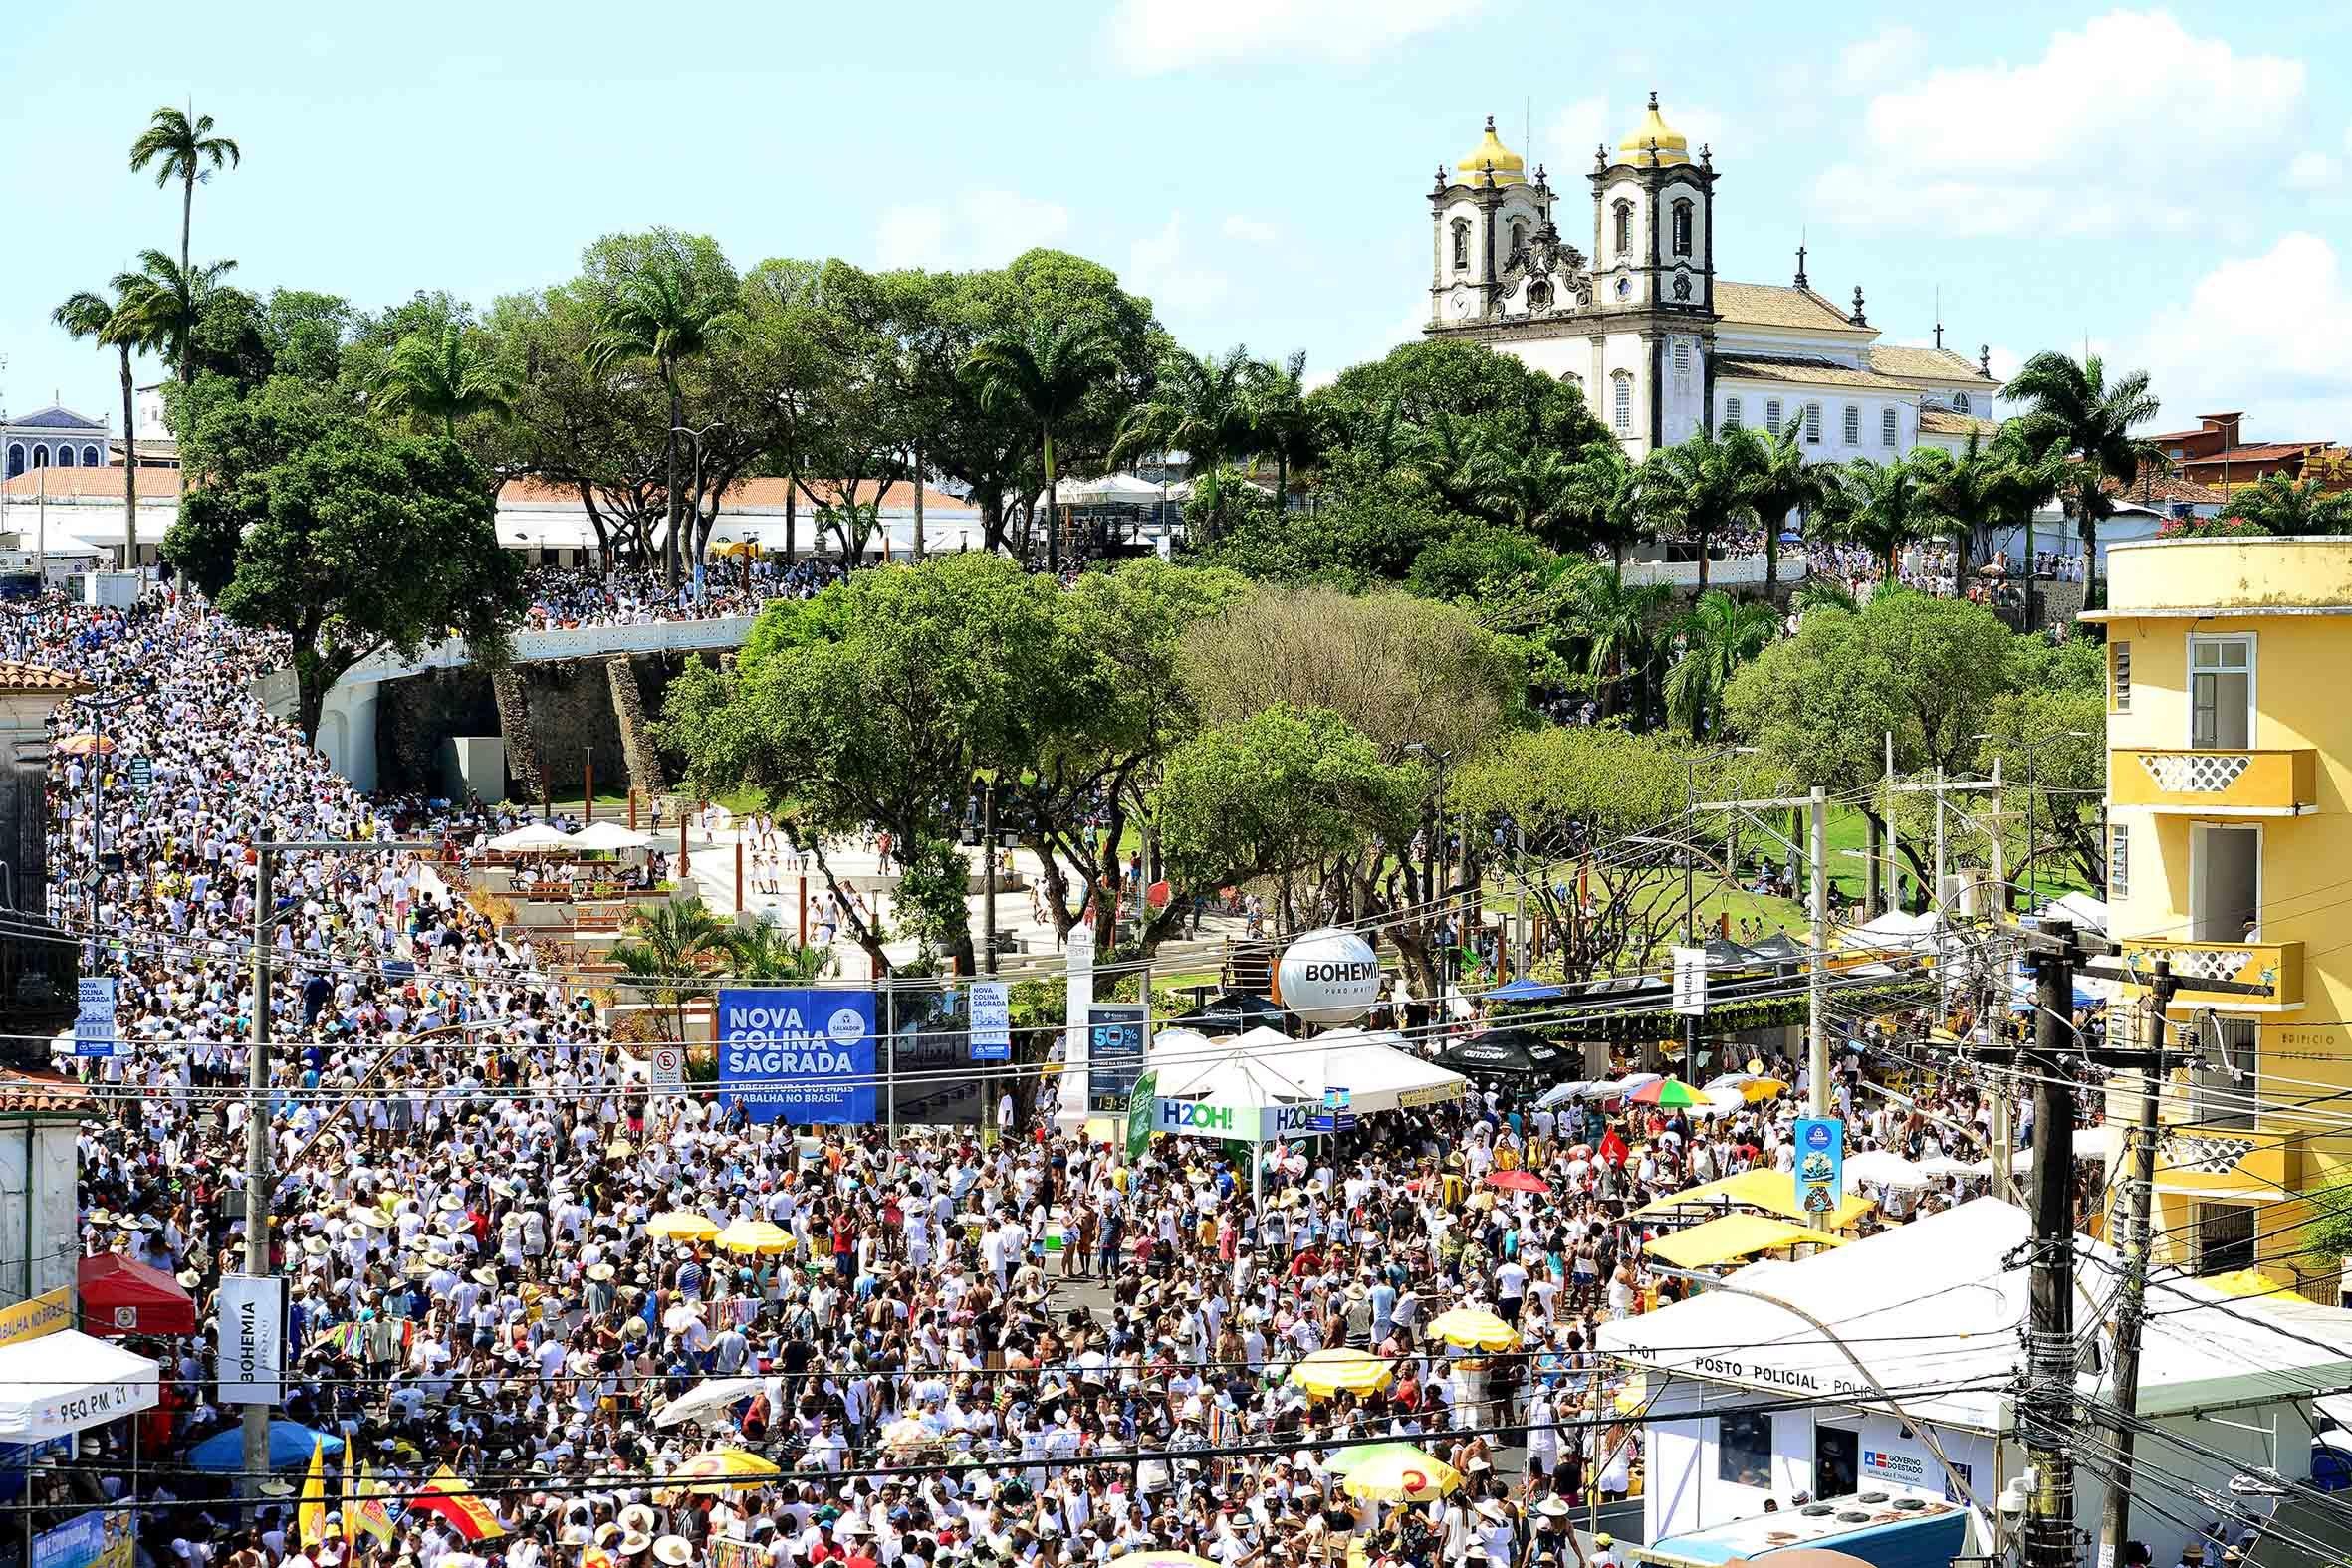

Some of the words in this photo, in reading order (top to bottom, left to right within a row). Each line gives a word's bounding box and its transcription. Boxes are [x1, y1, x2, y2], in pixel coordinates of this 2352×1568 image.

[1306, 961, 1381, 982] BOHEMI
[1684, 962, 1693, 1005] BOHEMIA
[729, 1008, 804, 1029] NOVA
[729, 1030, 828, 1051] COLINA
[729, 1052, 853, 1073] SAGRADA
[1464, 1050, 1509, 1060] ambev
[785, 1094, 803, 1103] NO
[1163, 1101, 1233, 1131] H2OH!
[241, 1301, 255, 1383] BOHEMIA
[1696, 1356, 1743, 1377] POSTO
[1754, 1365, 1820, 1391] POLICIAL
[91, 1391, 111, 1414] PM
[115, 1384, 128, 1405] 21
[1887, 1461, 1898, 1470] DO
[1897, 1463, 1924, 1474] ESTADO
[1888, 1455, 1922, 1466] GOVERNO
